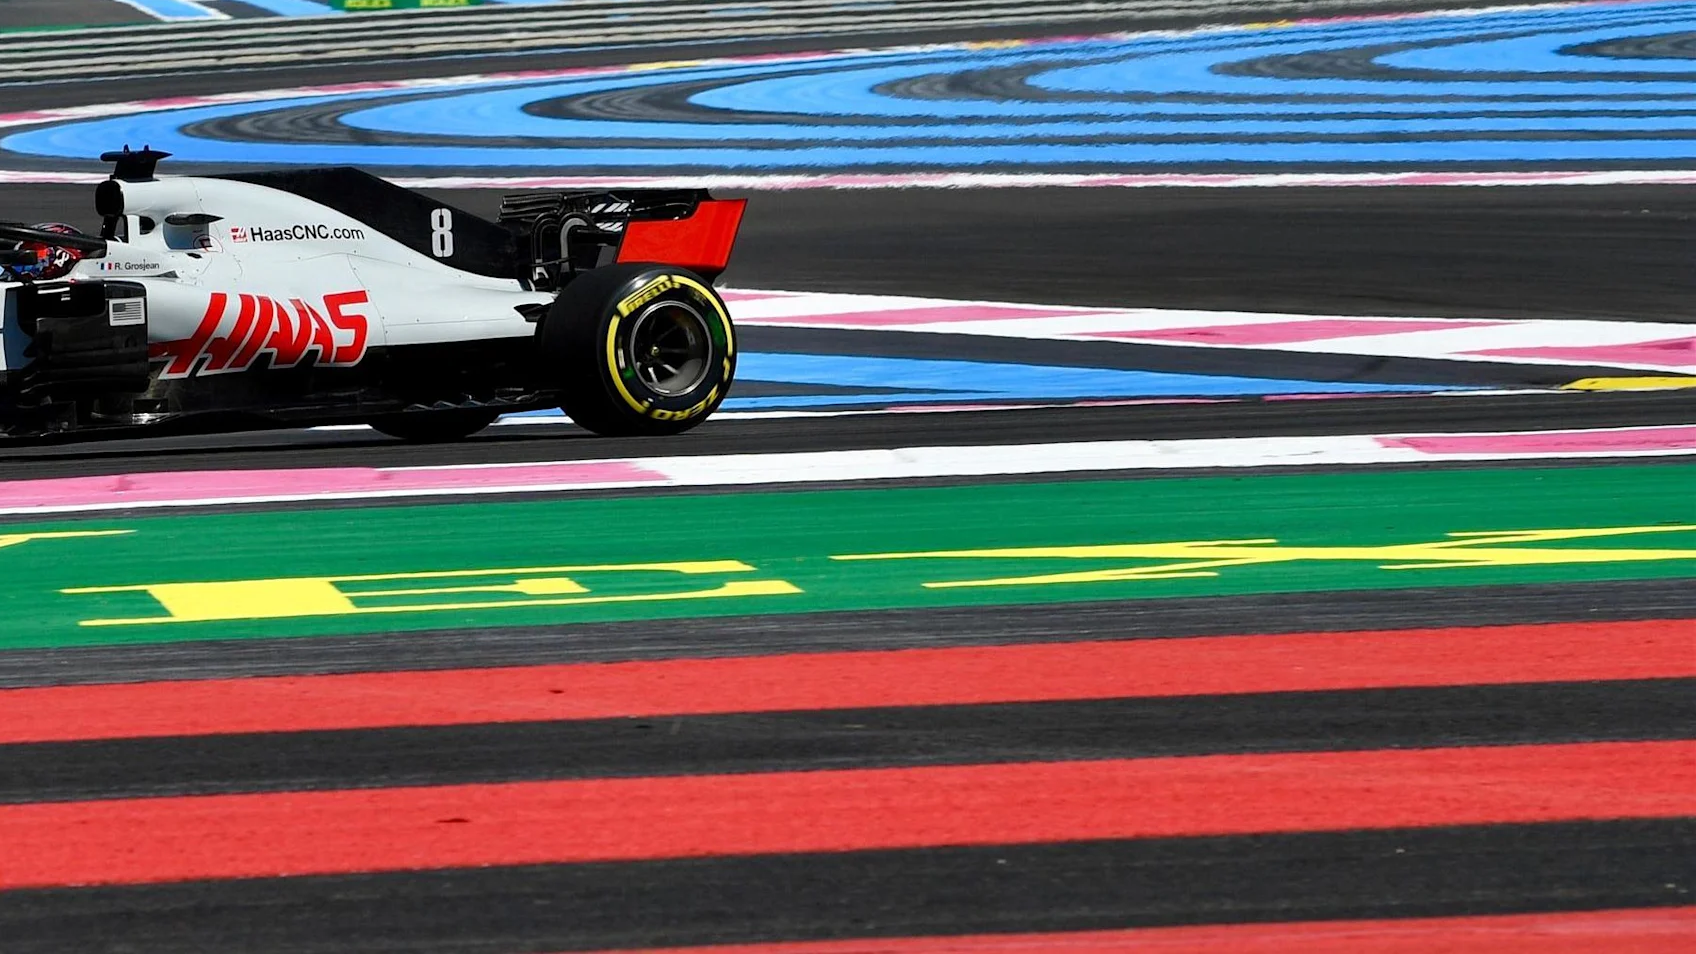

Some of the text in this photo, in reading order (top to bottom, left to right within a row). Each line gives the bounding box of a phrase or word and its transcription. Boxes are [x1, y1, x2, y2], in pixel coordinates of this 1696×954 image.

[250, 224, 365, 242] HaasCNC.com
[430, 207, 454, 258] 8
[114, 258, 160, 272] R. Grosjean
[149, 289, 370, 379] HAAS
